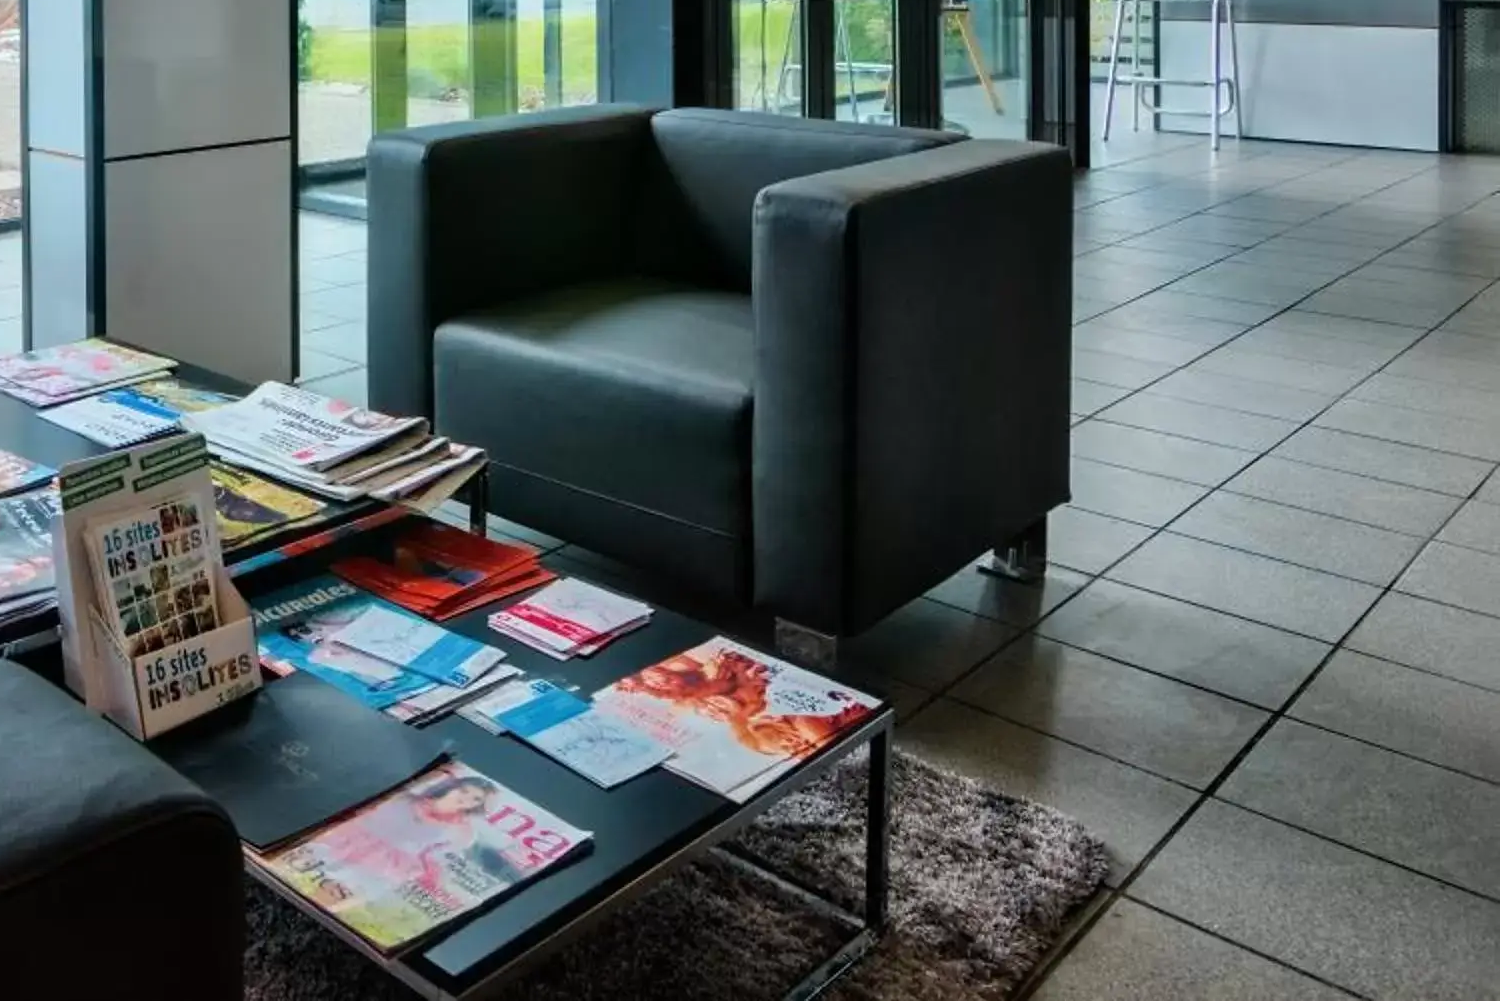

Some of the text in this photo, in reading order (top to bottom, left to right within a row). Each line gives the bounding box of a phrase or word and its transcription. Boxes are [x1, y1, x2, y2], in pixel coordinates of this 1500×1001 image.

[104, 520, 161, 555] 16 sites
[107, 528, 202, 579] INSOLITES
[146, 647, 207, 686] 16 sites
[148, 653, 253, 711] INSOLITES
